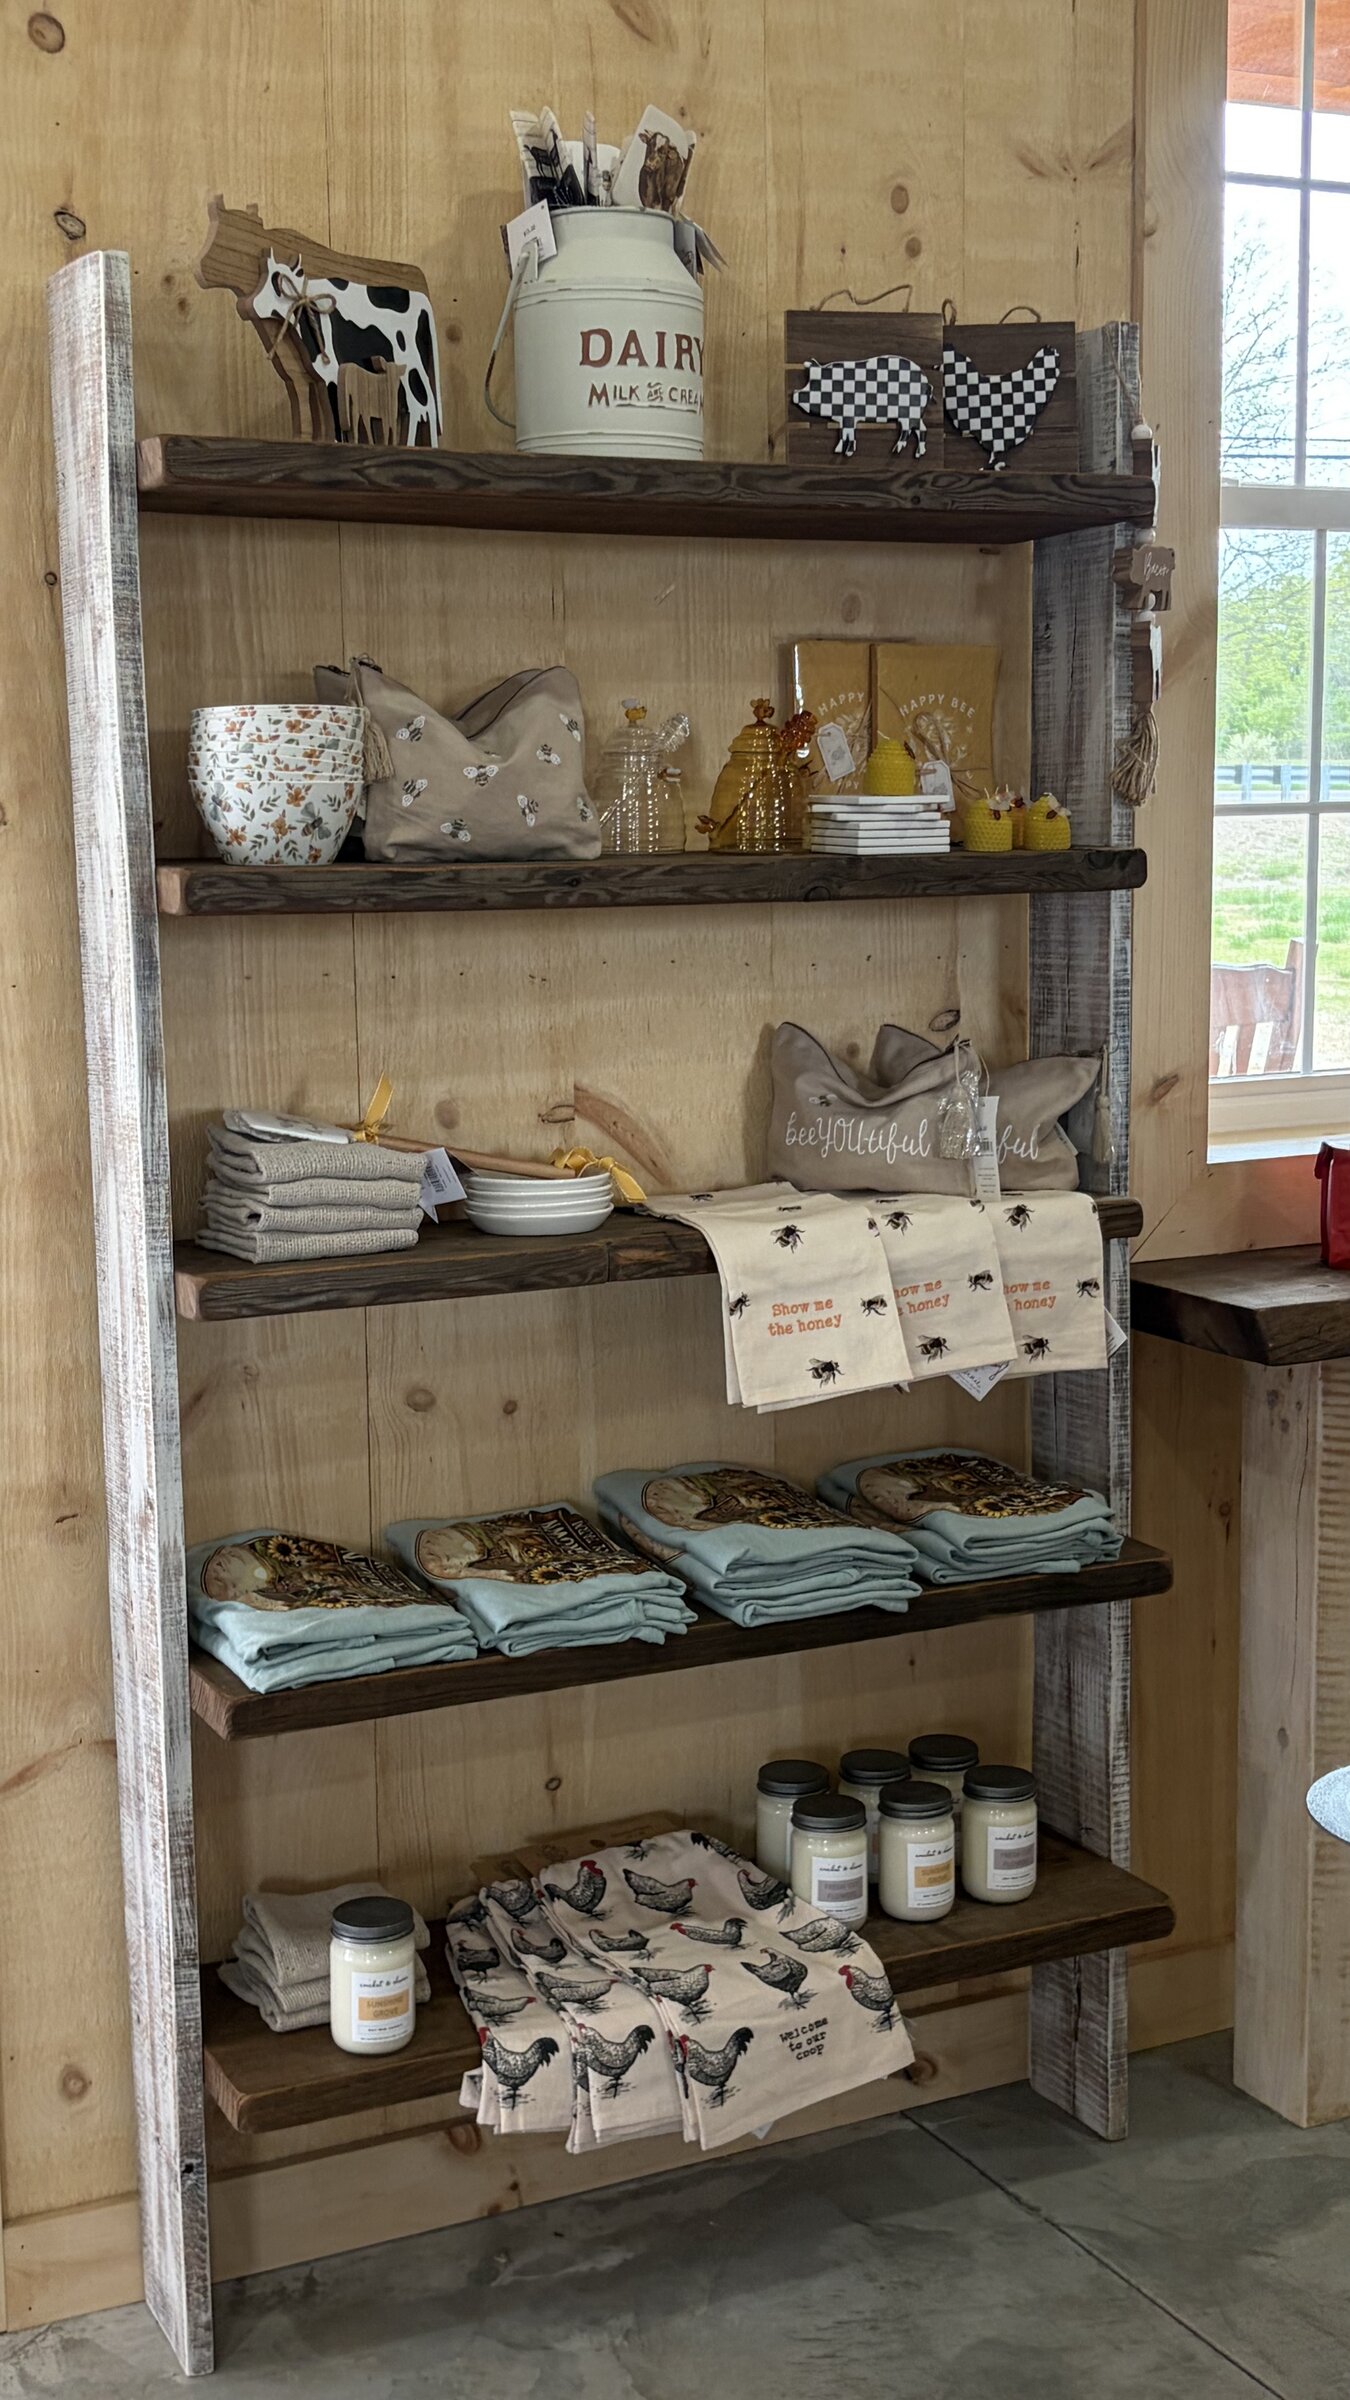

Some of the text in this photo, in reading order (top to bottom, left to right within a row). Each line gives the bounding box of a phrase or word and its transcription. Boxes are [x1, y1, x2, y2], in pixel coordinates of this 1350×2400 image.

[588, 382, 641, 407] MILK
[818, 692, 865, 716] HAPPY
[900, 693, 976, 719] HAPPY BEE
[921, 1279, 942, 1292] me
[1033, 1280, 1050, 1291] me
[772, 1298, 833, 1318] Show me
[907, 1293, 950, 1315] honey
[1015, 1294, 1056, 1310] honey
[767, 1313, 842, 1337] the honey
[779, 2017, 828, 2043] welcome
[789, 2031, 827, 2052] to our
[796, 2043, 824, 2061] coop
